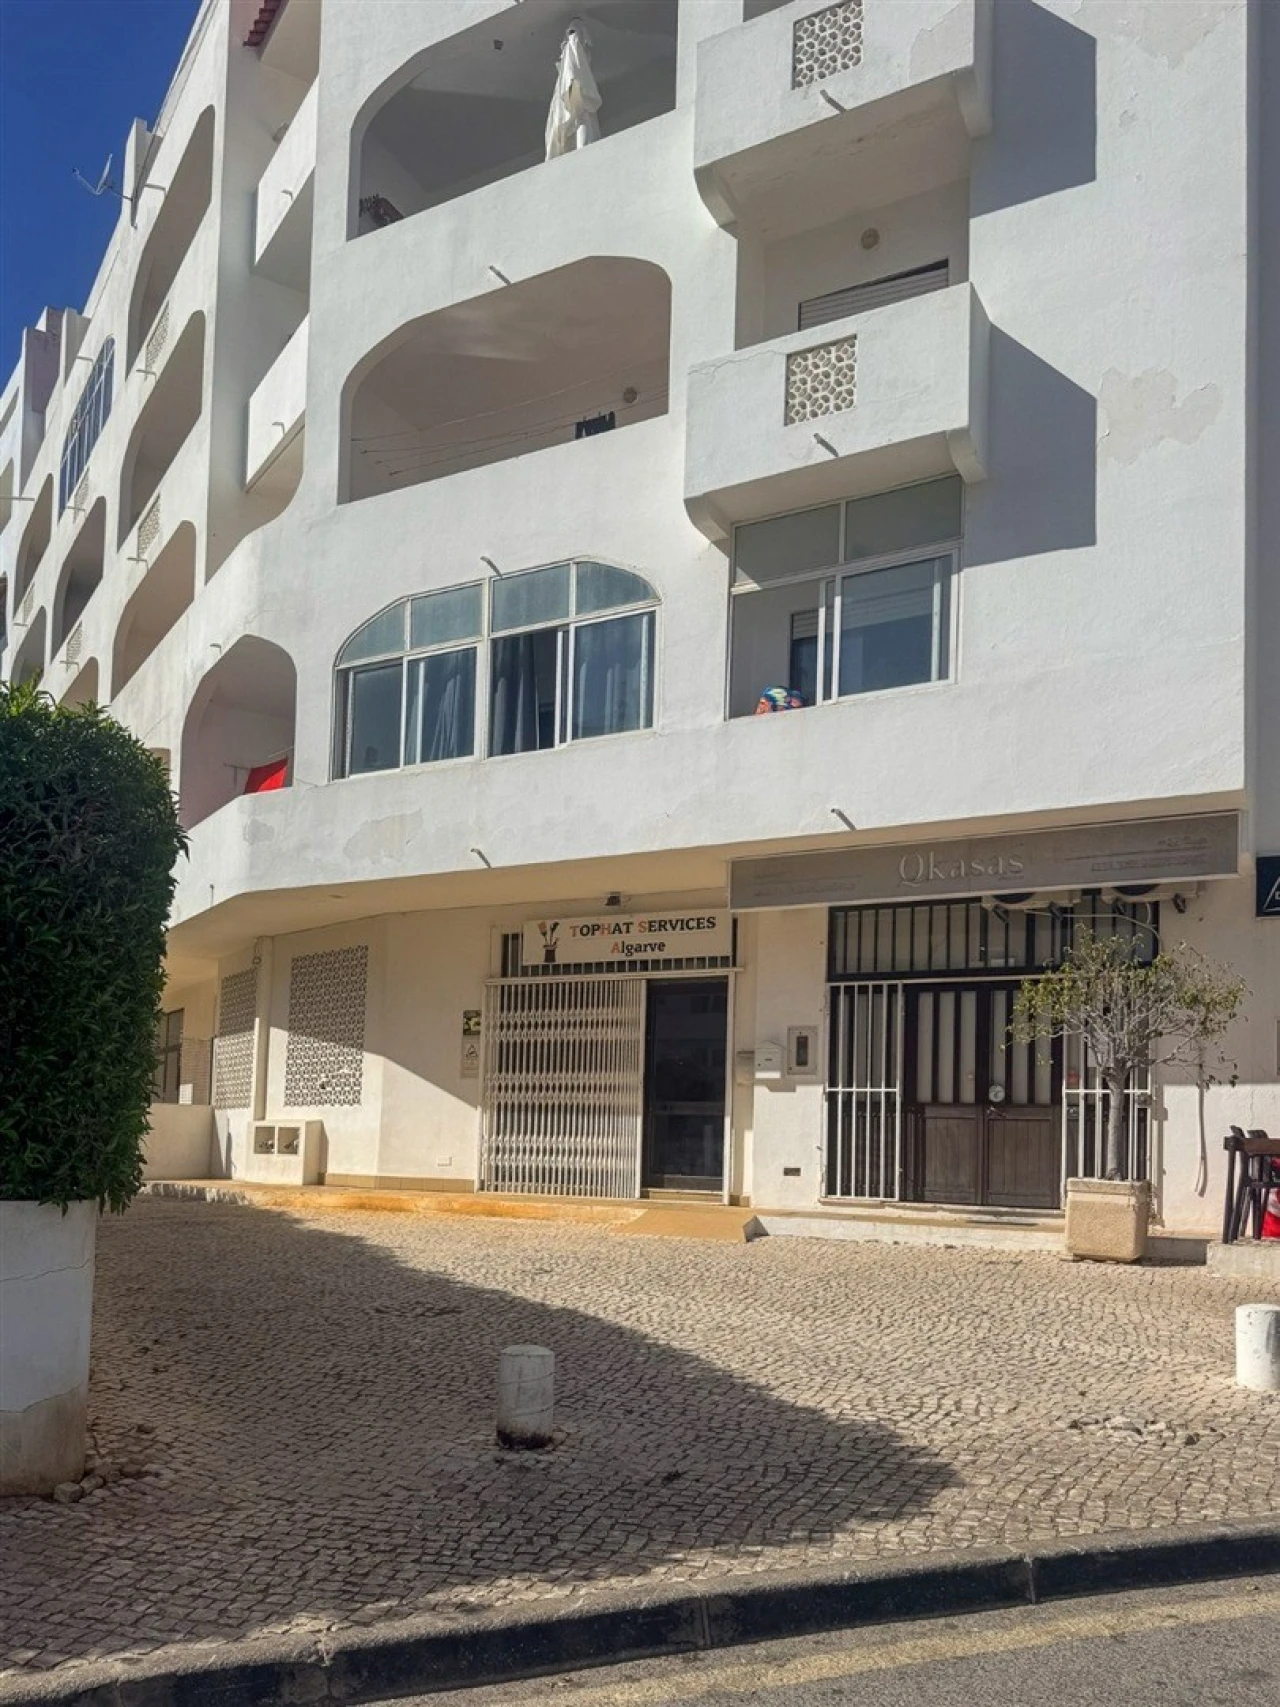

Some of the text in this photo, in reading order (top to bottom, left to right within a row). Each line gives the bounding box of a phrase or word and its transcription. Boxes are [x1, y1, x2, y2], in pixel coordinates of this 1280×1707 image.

[898, 849, 1024, 888] Qkasas
[570, 916, 717, 938] TOPHAT SERVICES
[610, 940, 666, 957] Algarve
